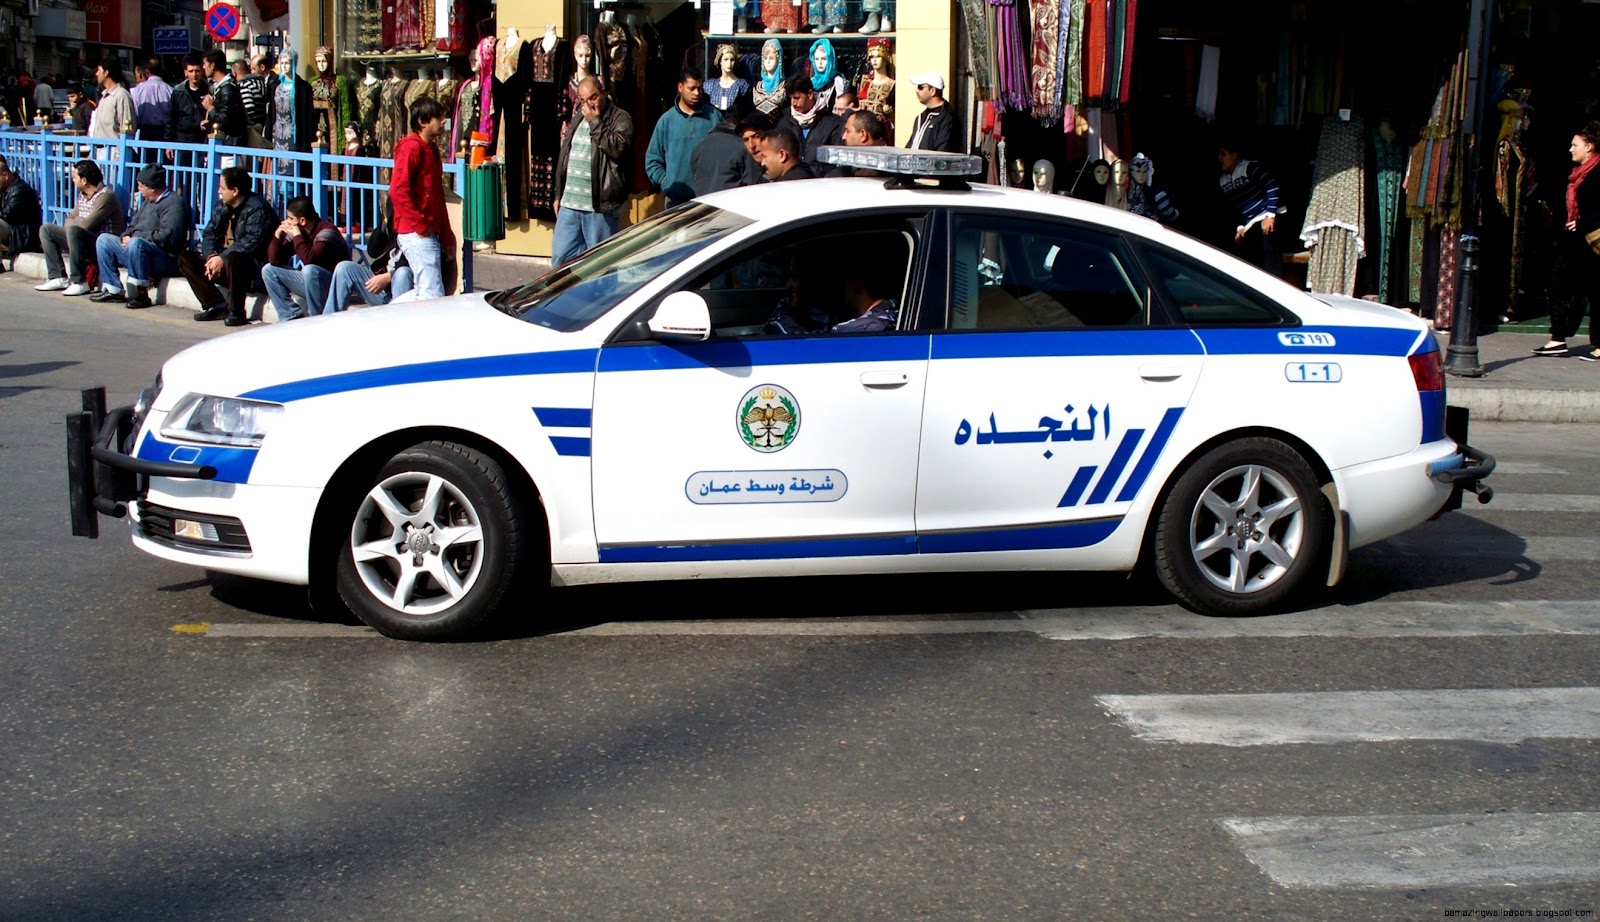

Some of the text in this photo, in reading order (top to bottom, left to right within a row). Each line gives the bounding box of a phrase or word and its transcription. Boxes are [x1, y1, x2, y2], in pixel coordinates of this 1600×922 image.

[954, 402, 1110, 460] النجده
[700, 476, 834, 496] شرطة وسط عمان
